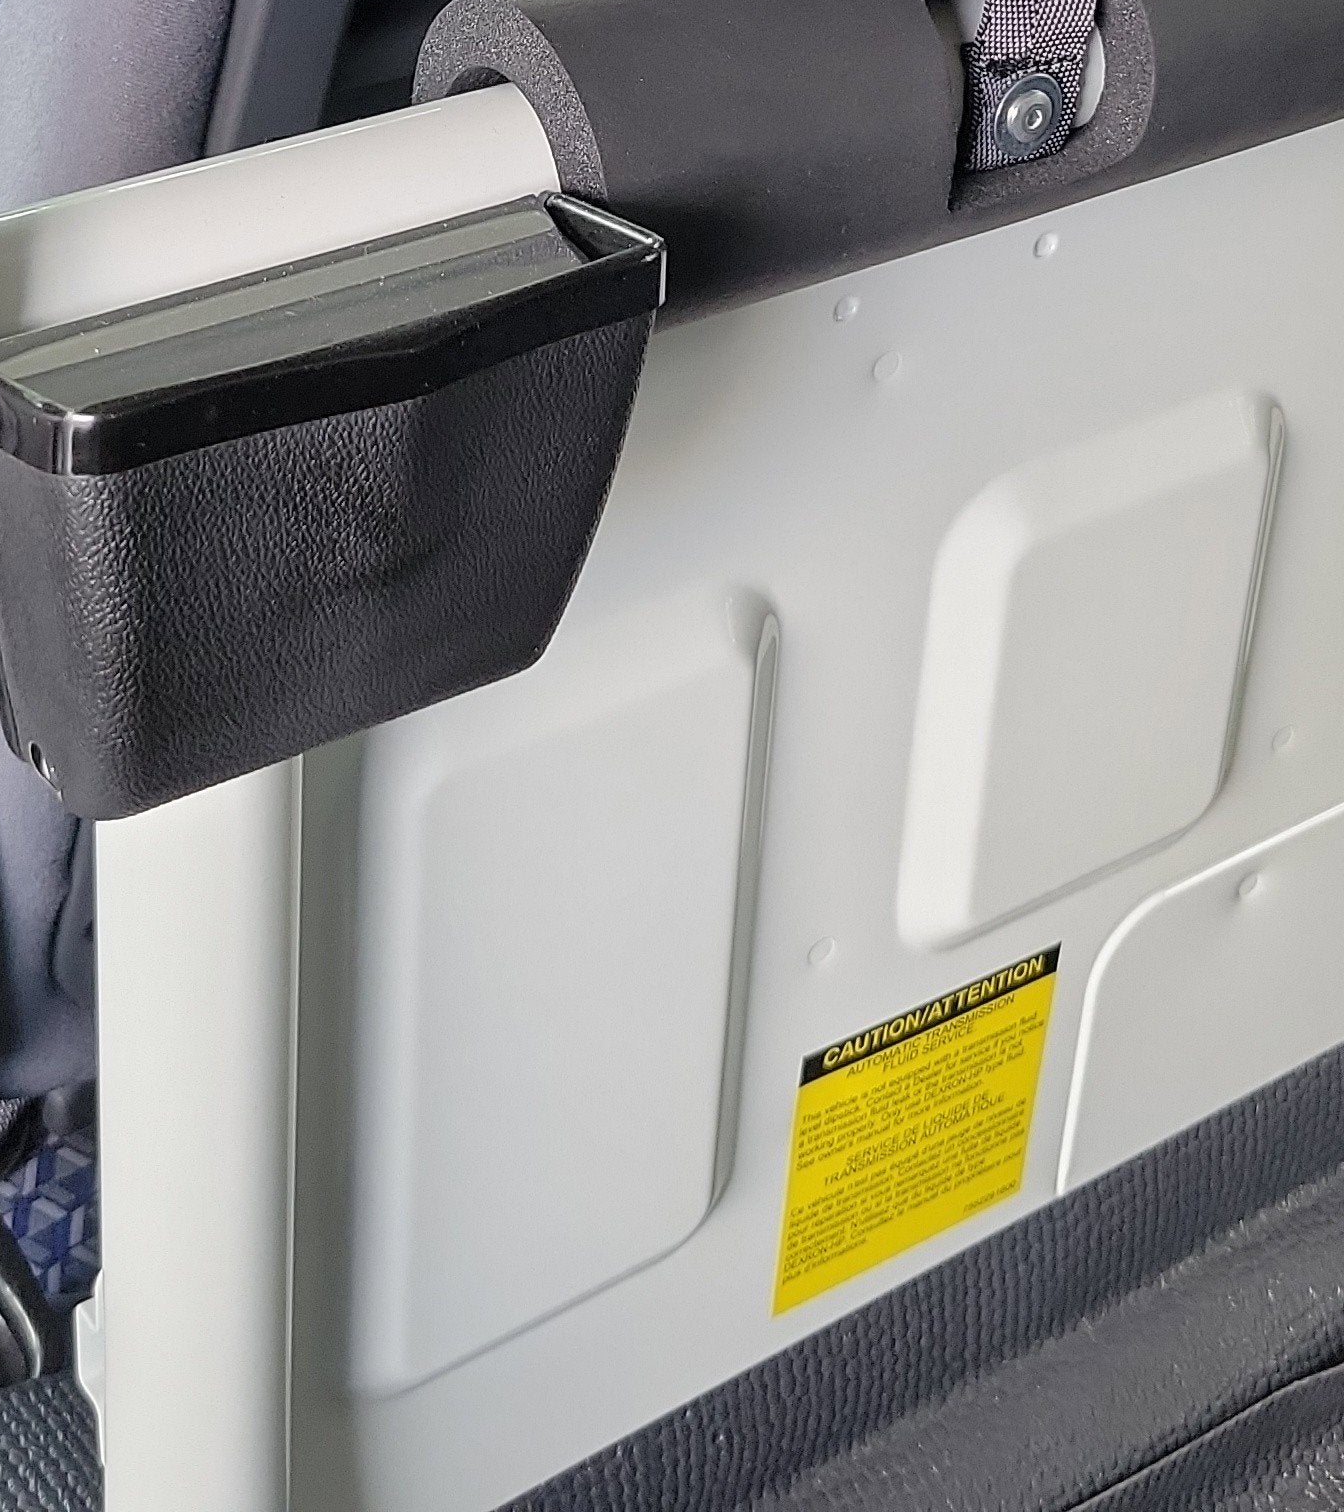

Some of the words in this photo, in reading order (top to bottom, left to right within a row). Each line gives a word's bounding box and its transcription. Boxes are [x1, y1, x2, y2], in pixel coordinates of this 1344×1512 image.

[822, 954, 1043, 1069] CAUTION/ATTENTION
[846, 1035, 921, 1078] AUTOMATIC
[924, 991, 1015, 1043] TRANSMISSION
[882, 1046, 919, 1072] FLUID
[921, 1021, 974, 1055] SERVICE
[823, 1133, 917, 1187] TRANSMISSION
[920, 1090, 1005, 1140] AUTOMATIQUE
[845, 1131, 900, 1167] SERVICE
[902, 1122, 920, 1140] DE
[922, 1098, 970, 1130] LIQUIDE
